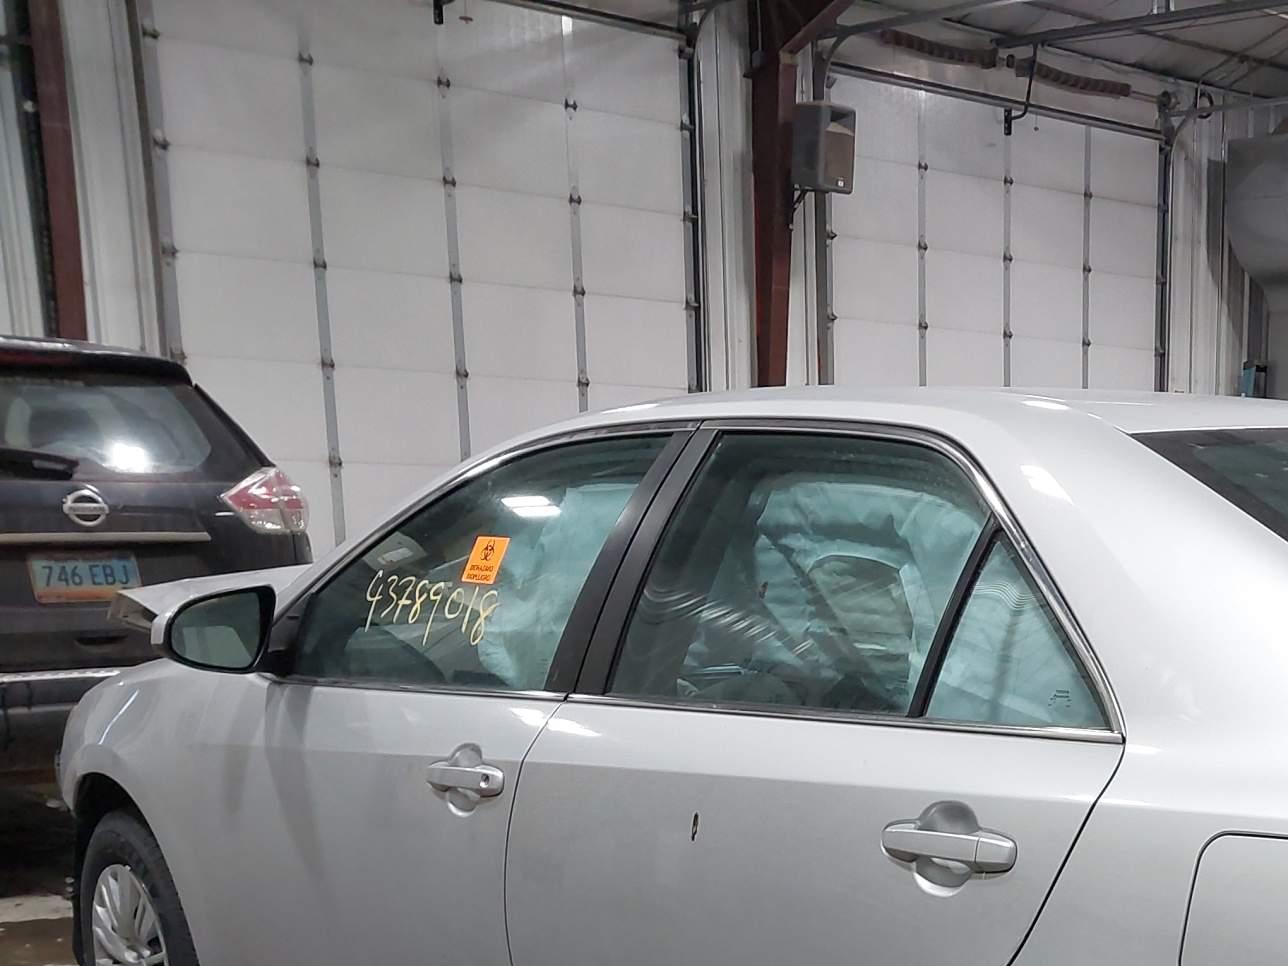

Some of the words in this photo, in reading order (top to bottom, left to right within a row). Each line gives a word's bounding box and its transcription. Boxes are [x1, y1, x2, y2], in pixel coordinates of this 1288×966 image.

[42, 565, 83, 587] 746
[88, 563, 131, 586] EBJ
[364, 569, 499, 646] 43789018
